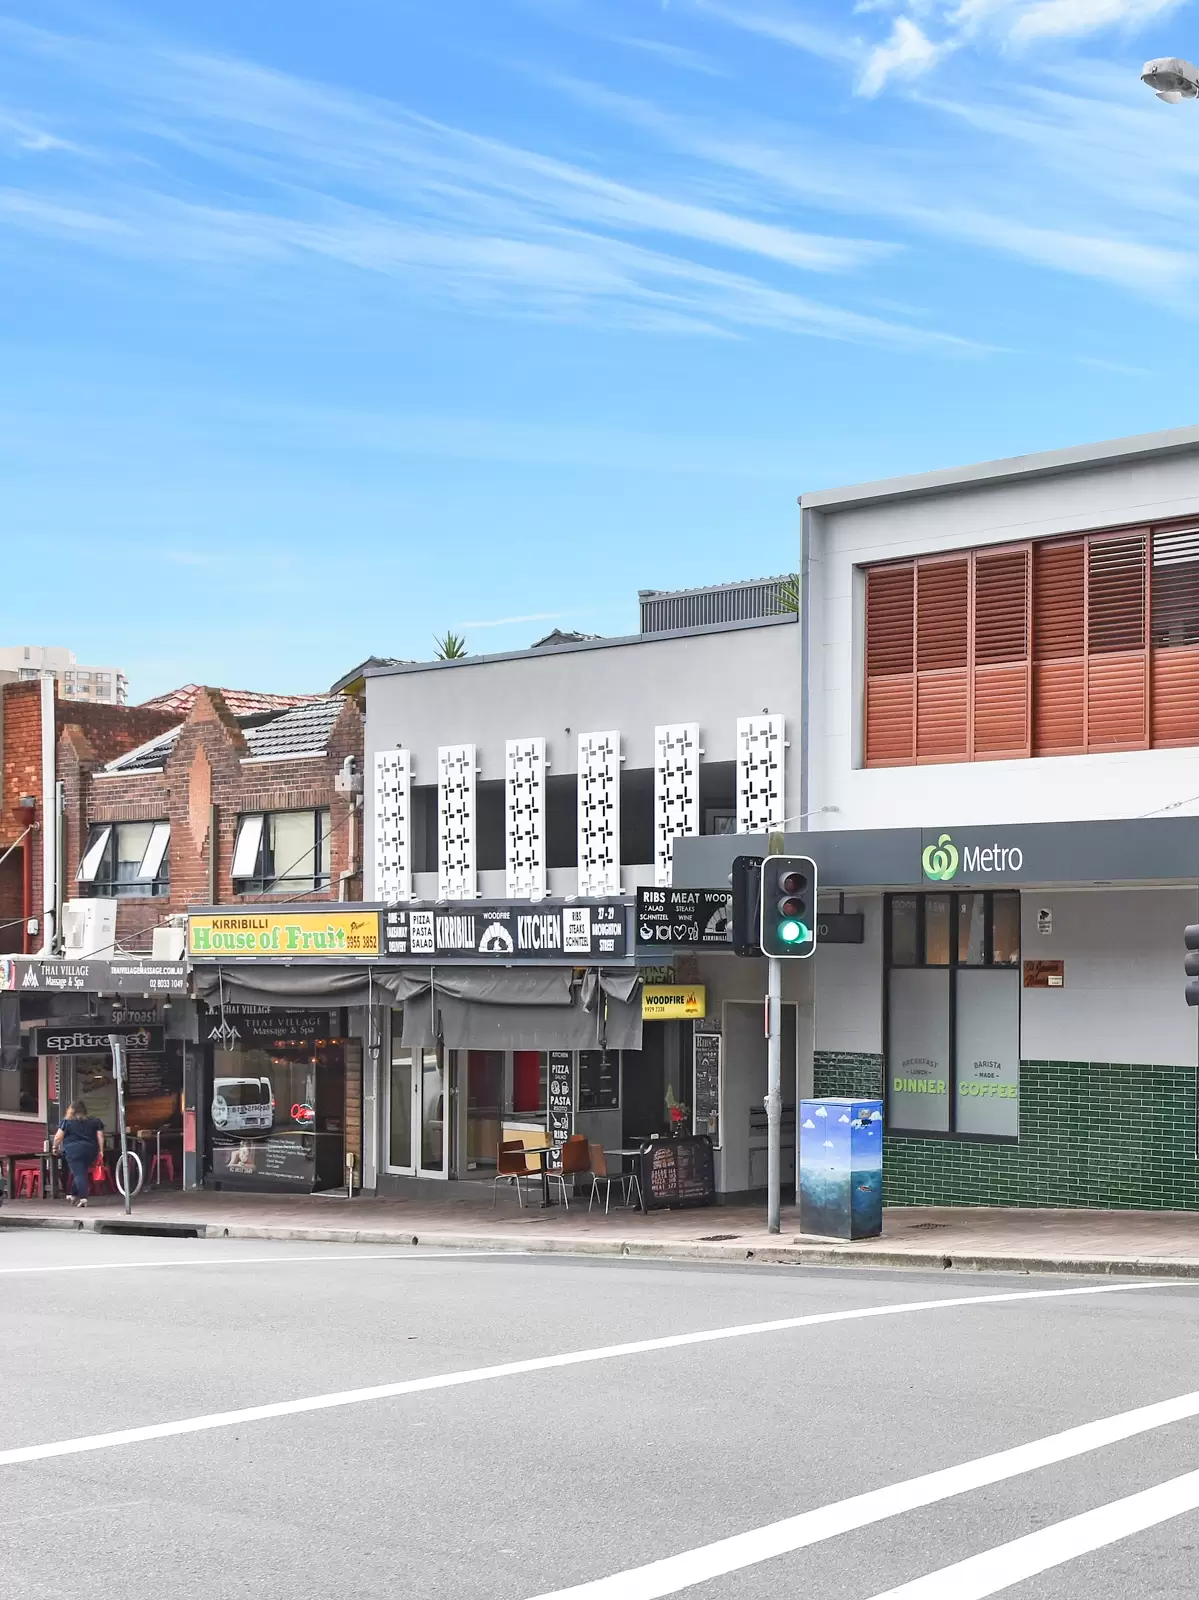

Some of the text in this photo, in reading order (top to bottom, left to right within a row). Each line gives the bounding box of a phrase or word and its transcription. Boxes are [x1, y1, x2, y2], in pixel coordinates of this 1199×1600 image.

[962, 842, 1023, 872] Metro
[643, 891, 700, 903] RIBS MEAT
[704, 893, 733, 903] WOOD
[413, 915, 431, 925] PIZZA
[483, 912, 510, 920] WOODFIRE
[572, 911, 582, 921] RIBS
[639, 913, 669, 921] SCHNITZEL
[212, 919, 269, 929] KIRRIBILLI
[569, 924, 585, 934] STEAKS
[412, 927, 432, 937] PASTA
[436, 915, 476, 949] KIRRIBILLI
[517, 914, 561, 949] KITCHEN
[193, 925, 346, 950] House of Fruit
[412, 939, 433, 949] SALAD
[41, 965, 90, 976] THAI VILLAGE
[45, 976, 84, 989] Massage & Spa
[149, 979, 184, 988] 02 8033 1049
[645, 995, 685, 1005] WOODFIRE
[245, 1018, 273, 1027] THAI
[252, 1027, 287, 1036] Massage
[300, 1026, 315, 1036] Spa
[901, 1058, 939, 1069] BREAKFAST
[973, 1060, 1002, 1070] BARISTA
[551, 1064, 570, 1074] PIZZA
[893, 1077, 947, 1095] DINNER
[958, 1080, 1018, 1099] COFFEE
[550, 1095, 571, 1106] PASTA
[553, 1130, 568, 1140] RIBS
